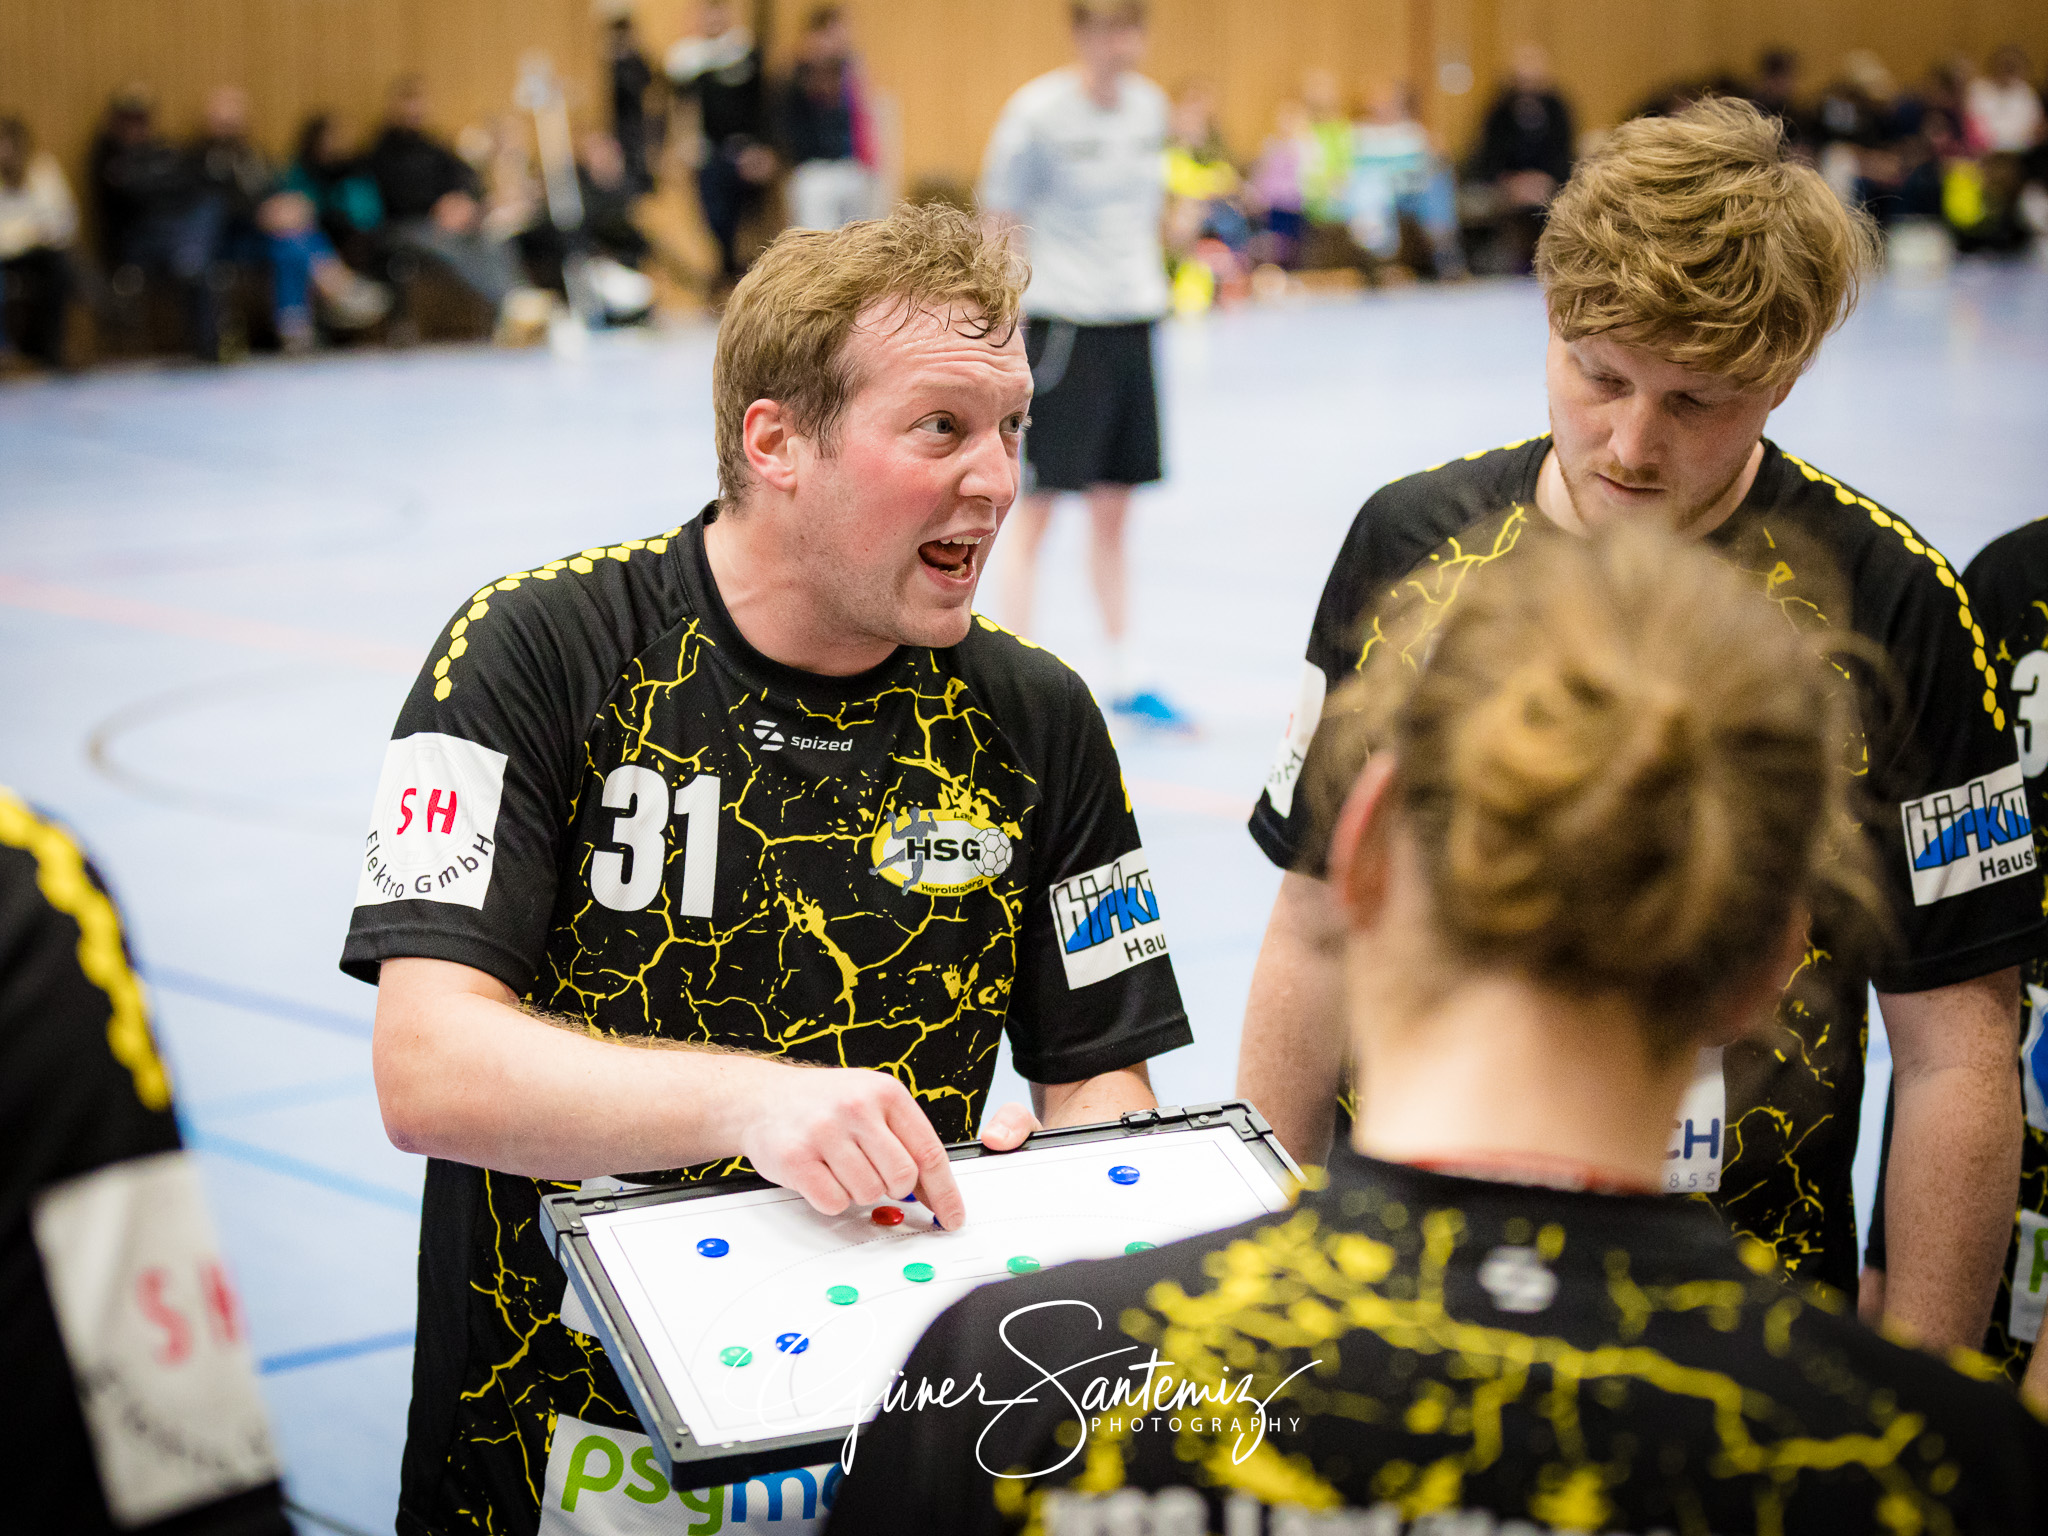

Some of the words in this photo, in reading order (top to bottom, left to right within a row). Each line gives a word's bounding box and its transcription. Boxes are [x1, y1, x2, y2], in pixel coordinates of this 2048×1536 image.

[791, 734, 854, 753] spized
[590, 765, 721, 918] 31
[906, 838, 981, 862] HSG
[366, 830, 405, 898] Elektro
[414, 833, 494, 894] GmbH
[1123, 933, 1167, 962] Hau
